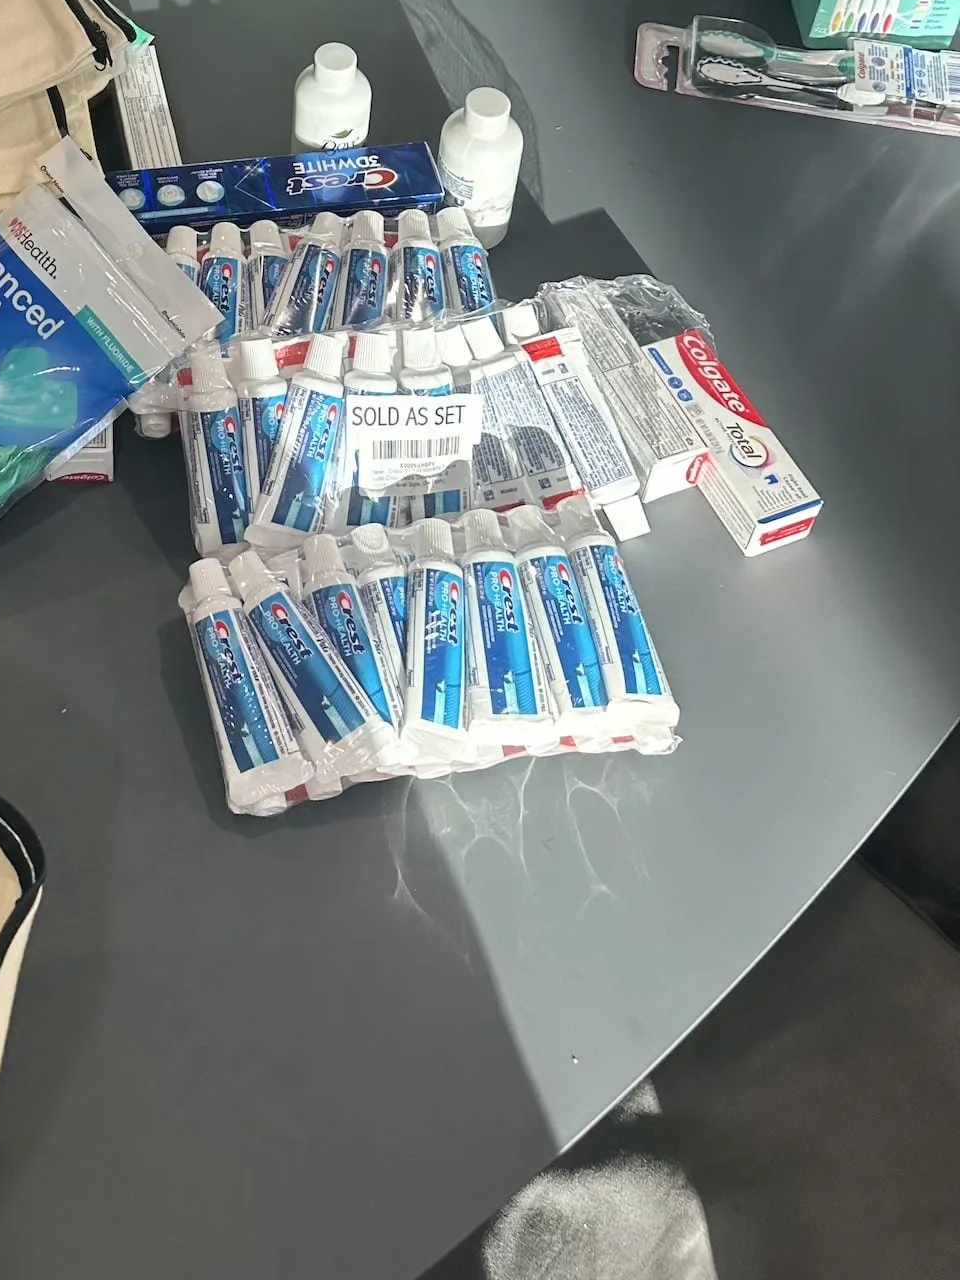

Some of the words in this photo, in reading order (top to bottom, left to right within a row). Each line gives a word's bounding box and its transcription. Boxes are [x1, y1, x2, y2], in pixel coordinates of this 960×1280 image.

[284, 169, 398, 194] Crest
[220, 262, 231, 312] Crest
[315, 257, 336, 305] Crest
[366, 257, 381, 308] Crest
[423, 254, 438, 304] Crest
[85, 316, 104, 337] WITH
[101, 334, 135, 373] FLUORIDE
[680, 329, 748, 417] Colgate
[222, 415, 243, 474] Crest
[315, 403, 337, 463] Crest
[351, 406, 399, 426] SOLD
[405, 406, 428, 425] AS
[434, 405, 465, 425] SET
[725, 420, 760, 460] Total
[334, 588, 366, 656] Crest
[448, 581, 458, 646] Crest
[497, 567, 519, 633] Crest
[555, 561, 584, 626] Crest
[211, 617, 246, 684] Crest
[269, 600, 314, 660] Crest
